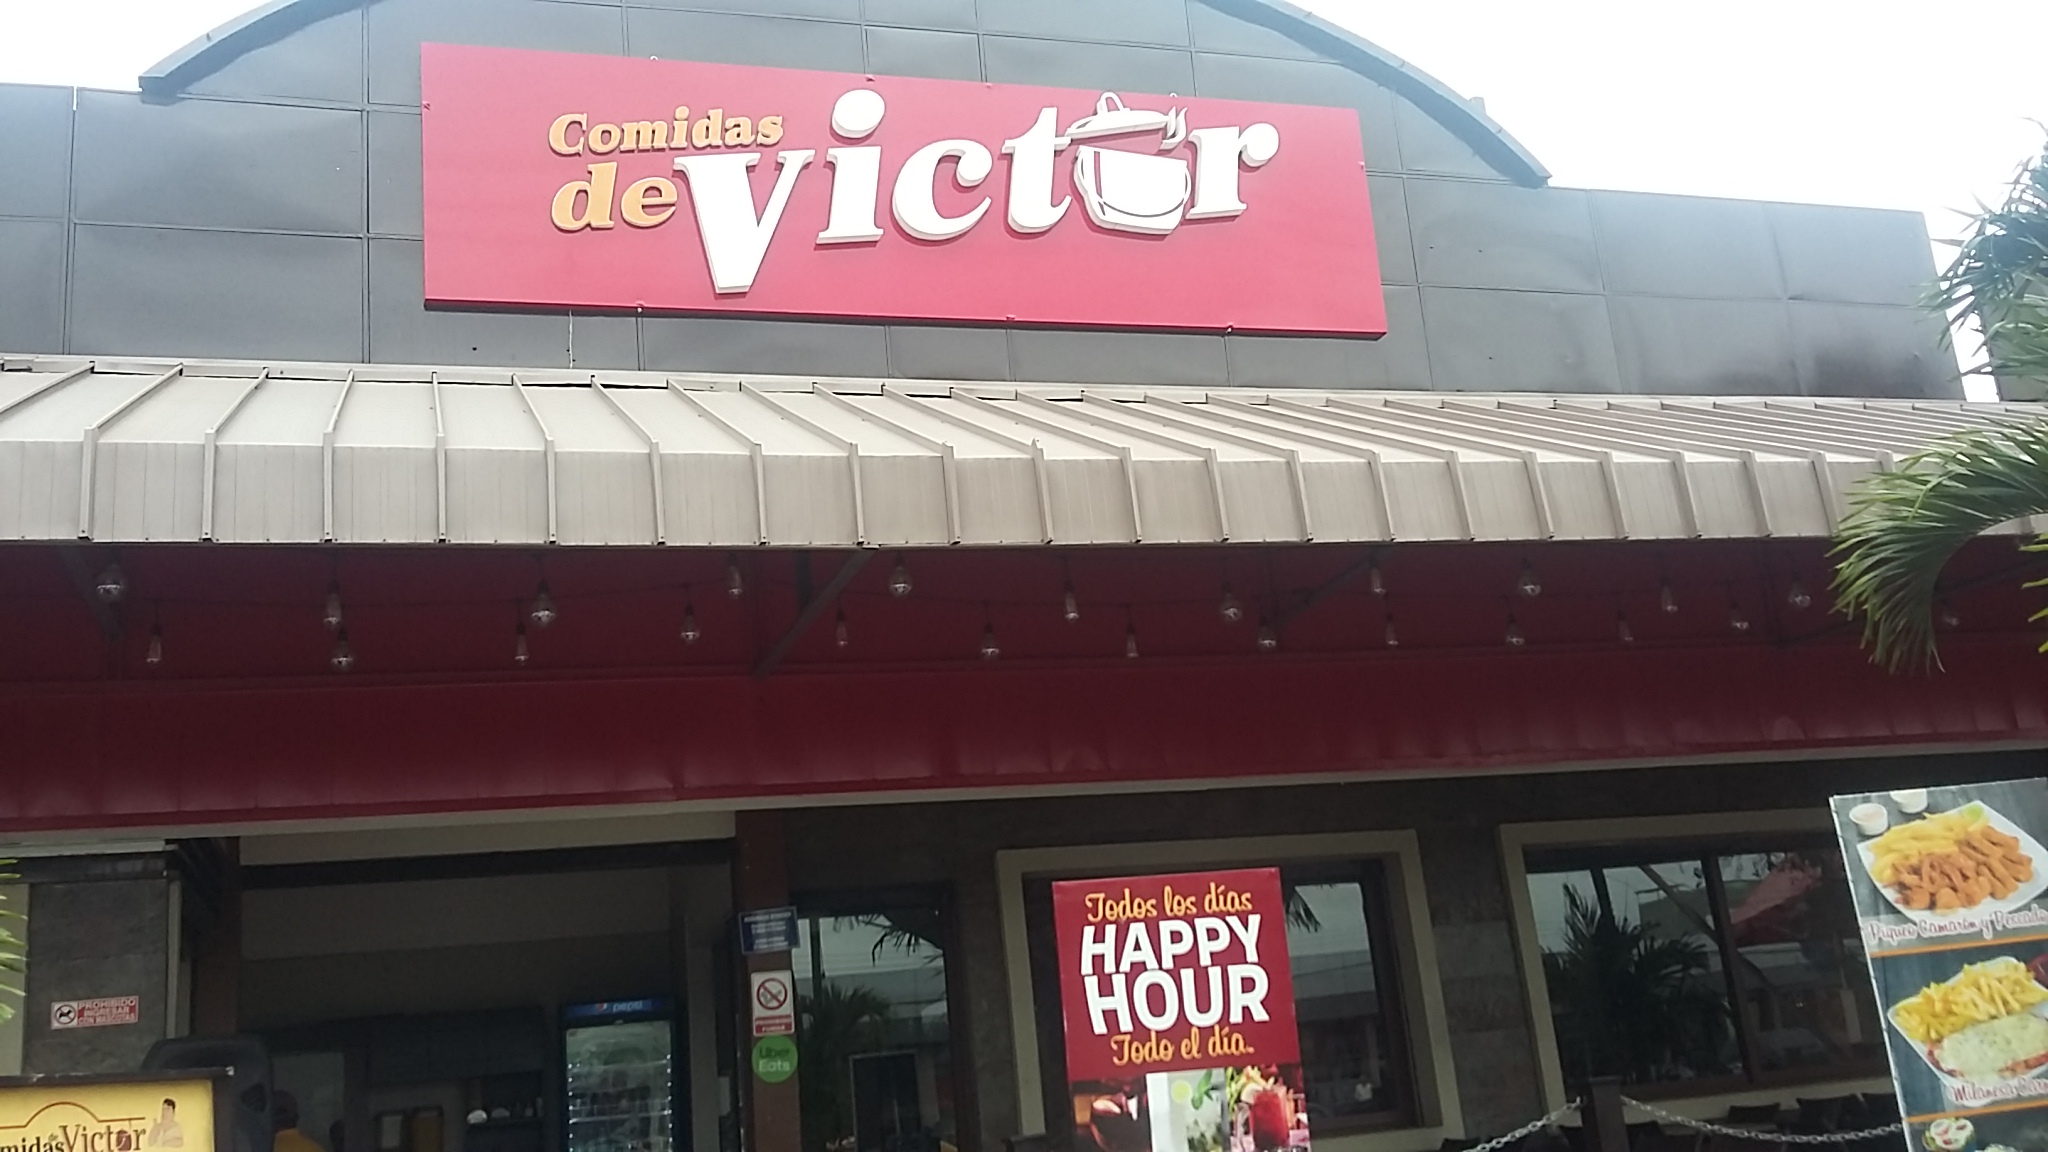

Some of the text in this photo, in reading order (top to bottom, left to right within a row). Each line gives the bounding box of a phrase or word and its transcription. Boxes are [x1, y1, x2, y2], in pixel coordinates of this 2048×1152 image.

[548, 106, 783, 155] Comidas
[551, 89, 1281, 294] de Victor
[1084, 881, 1253, 923] Todos los días
[1080, 914, 1261, 975] HAPPY
[1083, 964, 1270, 1035] HOUR
[758, 1059, 791, 1073] Eats
[1110, 1030, 1174, 1066] Todo
[1180, 1027, 1201, 1060] el
[59, 1123, 147, 1152] Victor
